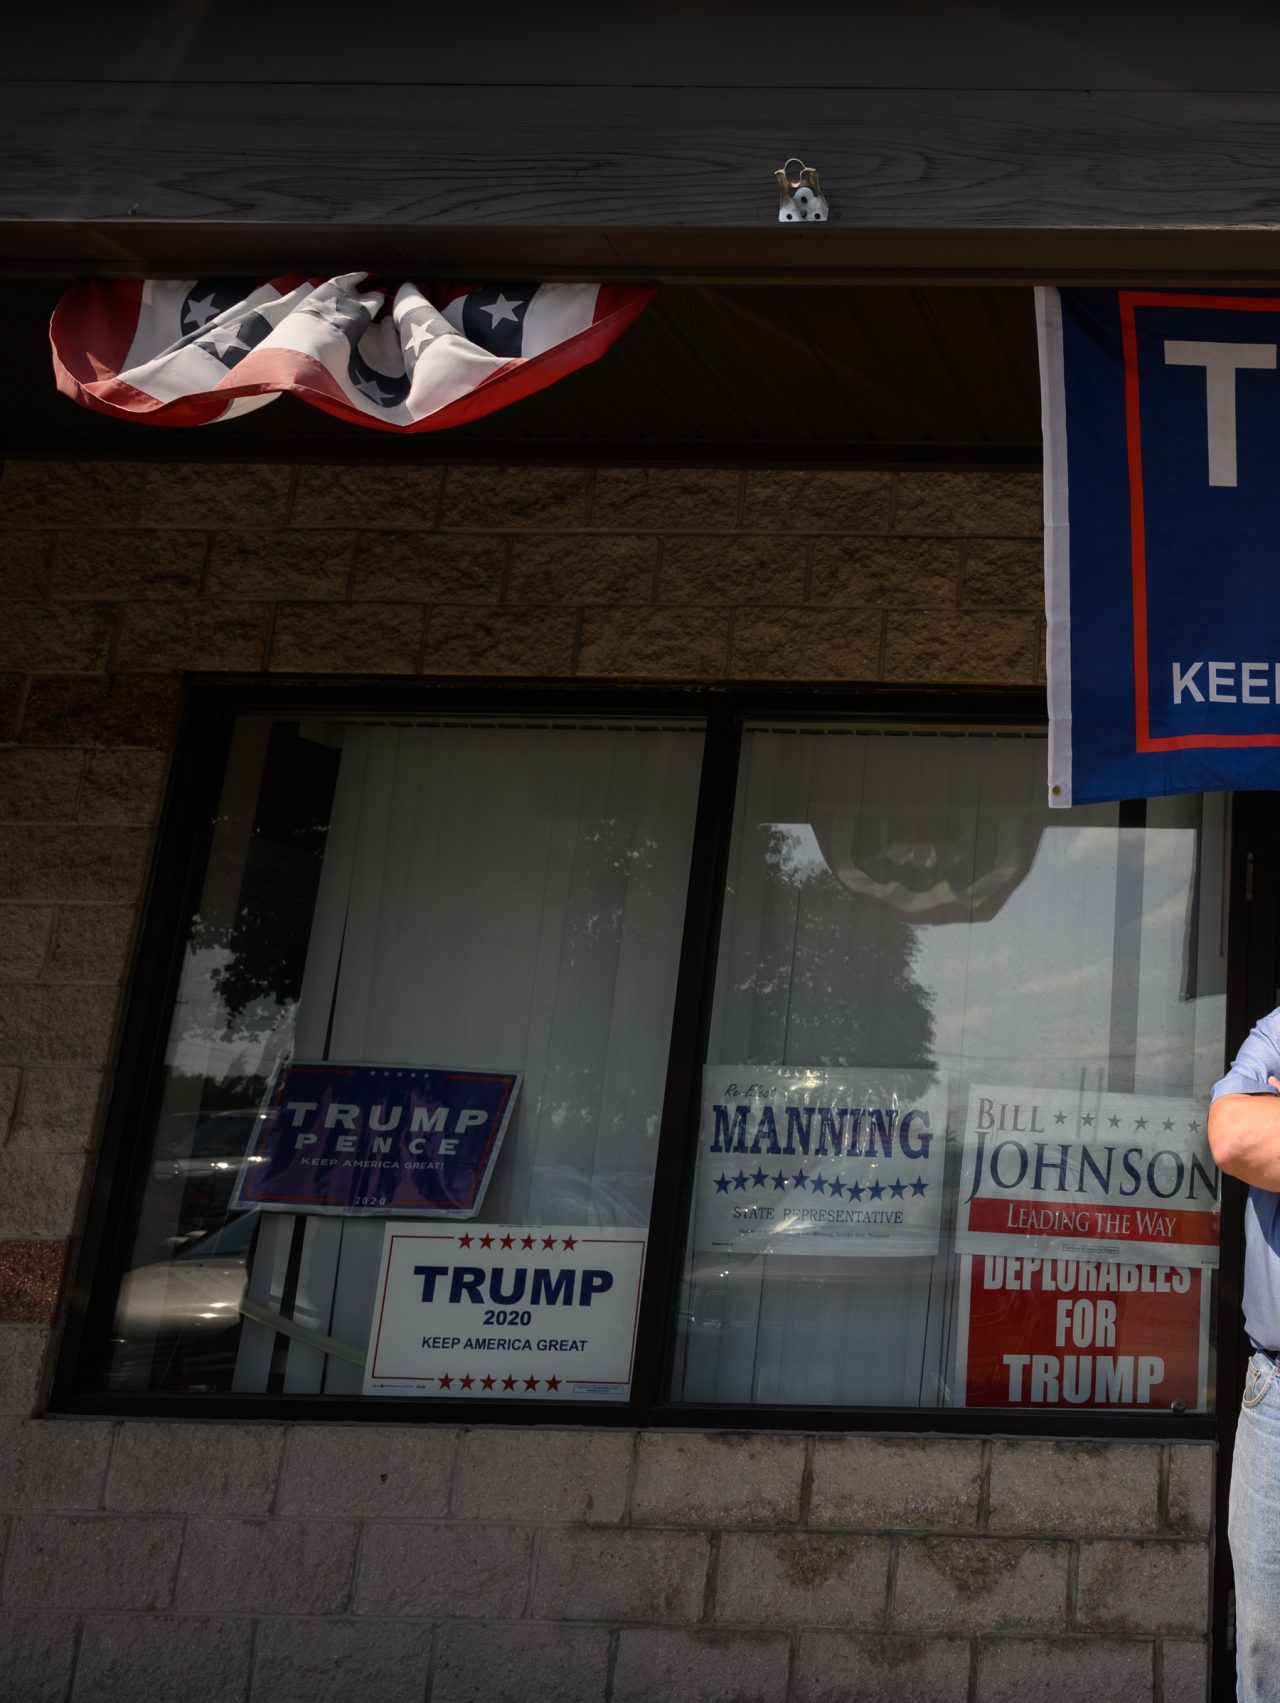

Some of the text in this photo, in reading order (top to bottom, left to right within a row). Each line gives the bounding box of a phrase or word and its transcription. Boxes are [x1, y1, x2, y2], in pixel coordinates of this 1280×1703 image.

[287, 1102, 488, 1133] TRUMP
[977, 1098, 1045, 1133] BILL
[295, 1133, 460, 1155] PENCE
[710, 1105, 933, 1159] MANNING
[301, 1157, 445, 1170] KEEP AMERICA GREAT!
[965, 1131, 1218, 1205] JOHNSON
[354, 1196, 386, 1206] 2020
[733, 1207, 904, 1224] STATE REPRESENTATIVE
[1006, 1203, 1177, 1237] LEADING THE WAY
[414, 1266, 613, 1306] TRUMP
[483, 1310, 531, 1326] 2020
[1056, 1299, 1117, 1348] FOR
[422, 1337, 588, 1352] KEEP AMERICA GREAT
[1003, 1354, 1165, 1404] TRUMP
